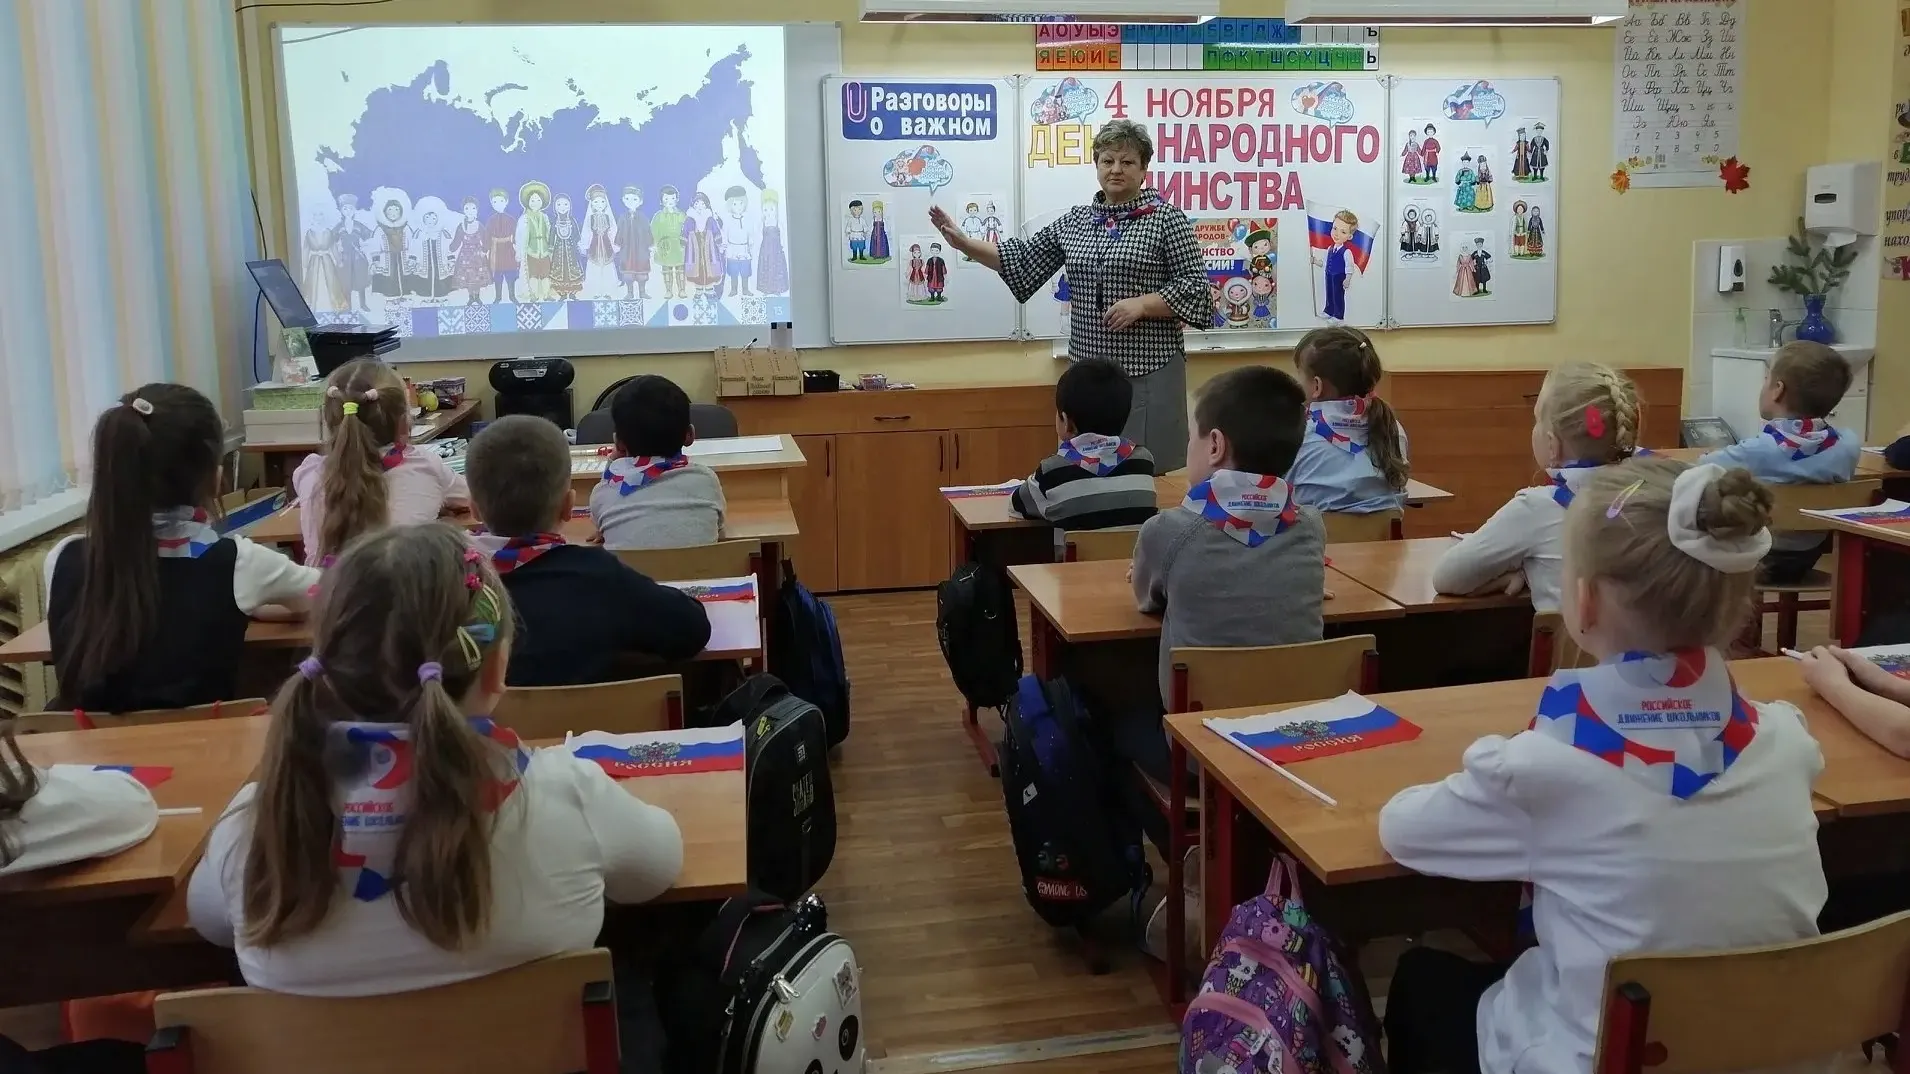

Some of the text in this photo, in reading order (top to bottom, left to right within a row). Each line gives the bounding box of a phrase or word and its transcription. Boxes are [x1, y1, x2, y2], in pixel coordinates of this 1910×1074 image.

[871, 86, 991, 116] Разговоры
[1104, 80, 1128, 118] 4
[1147, 88, 1275, 118] НОЯБРЯ
[870, 117, 991, 136] о важном
[1157, 123, 1380, 167] НАРОДНОГО
[1144, 171, 1305, 211] ИНСТВА
[1205, 259, 1235, 271] СИИ!
